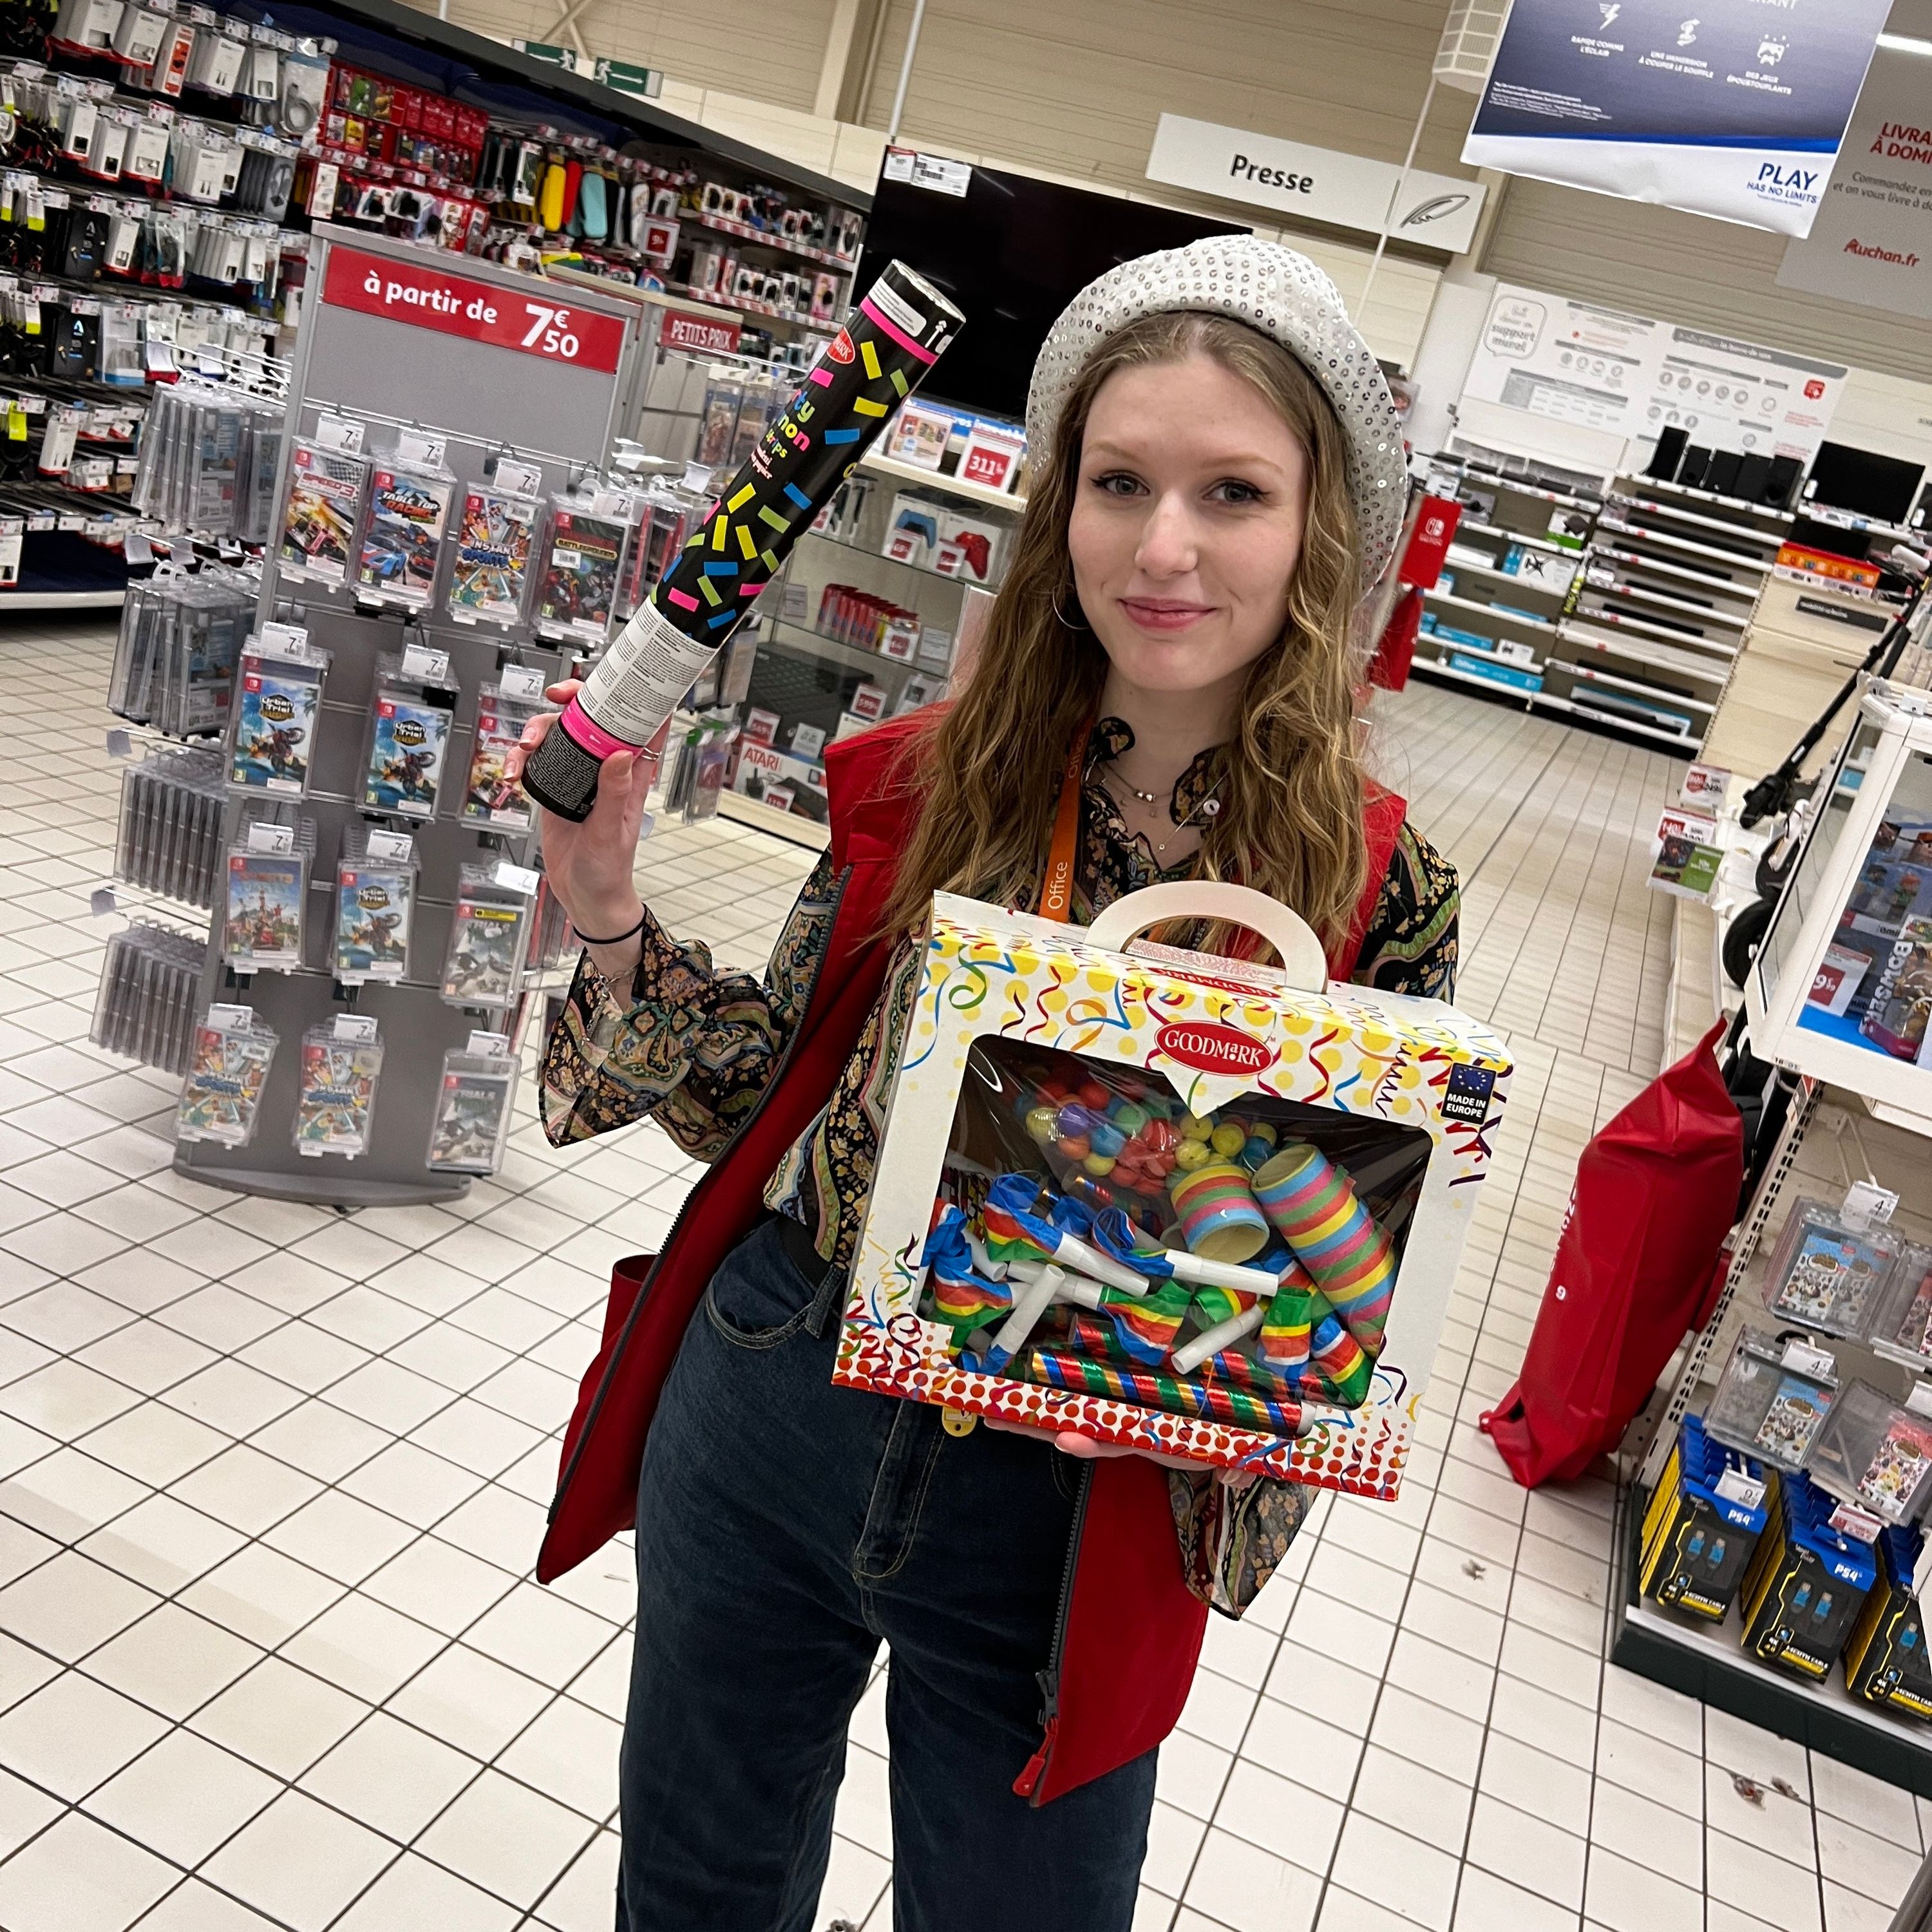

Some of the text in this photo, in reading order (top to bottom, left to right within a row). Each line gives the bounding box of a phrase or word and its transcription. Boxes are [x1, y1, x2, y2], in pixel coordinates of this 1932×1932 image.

[1230, 154, 1314, 194] Presse
[1758, 163, 1818, 190] PLAY
[1747, 181, 1765, 193] HAS
[1768, 186, 1783, 196] NO
[1785, 190, 1817, 204] LIMITS
[1888, 191, 1911, 207] livre
[1843, 238, 1920, 267] Auchan.fr
[363, 270, 380, 295] à
[385, 281, 462, 314] partir
[466, 298, 497, 324] de
[743, 748, 780, 771] ATARI
[1048, 862, 1067, 909] Office
[1446, 1103, 1482, 1118] EUROPE
[1447, 1094, 1486, 1108] MADE IN
[1728, 1509, 1752, 1526] PS4
[1835, 1563, 1859, 1582] PS4
